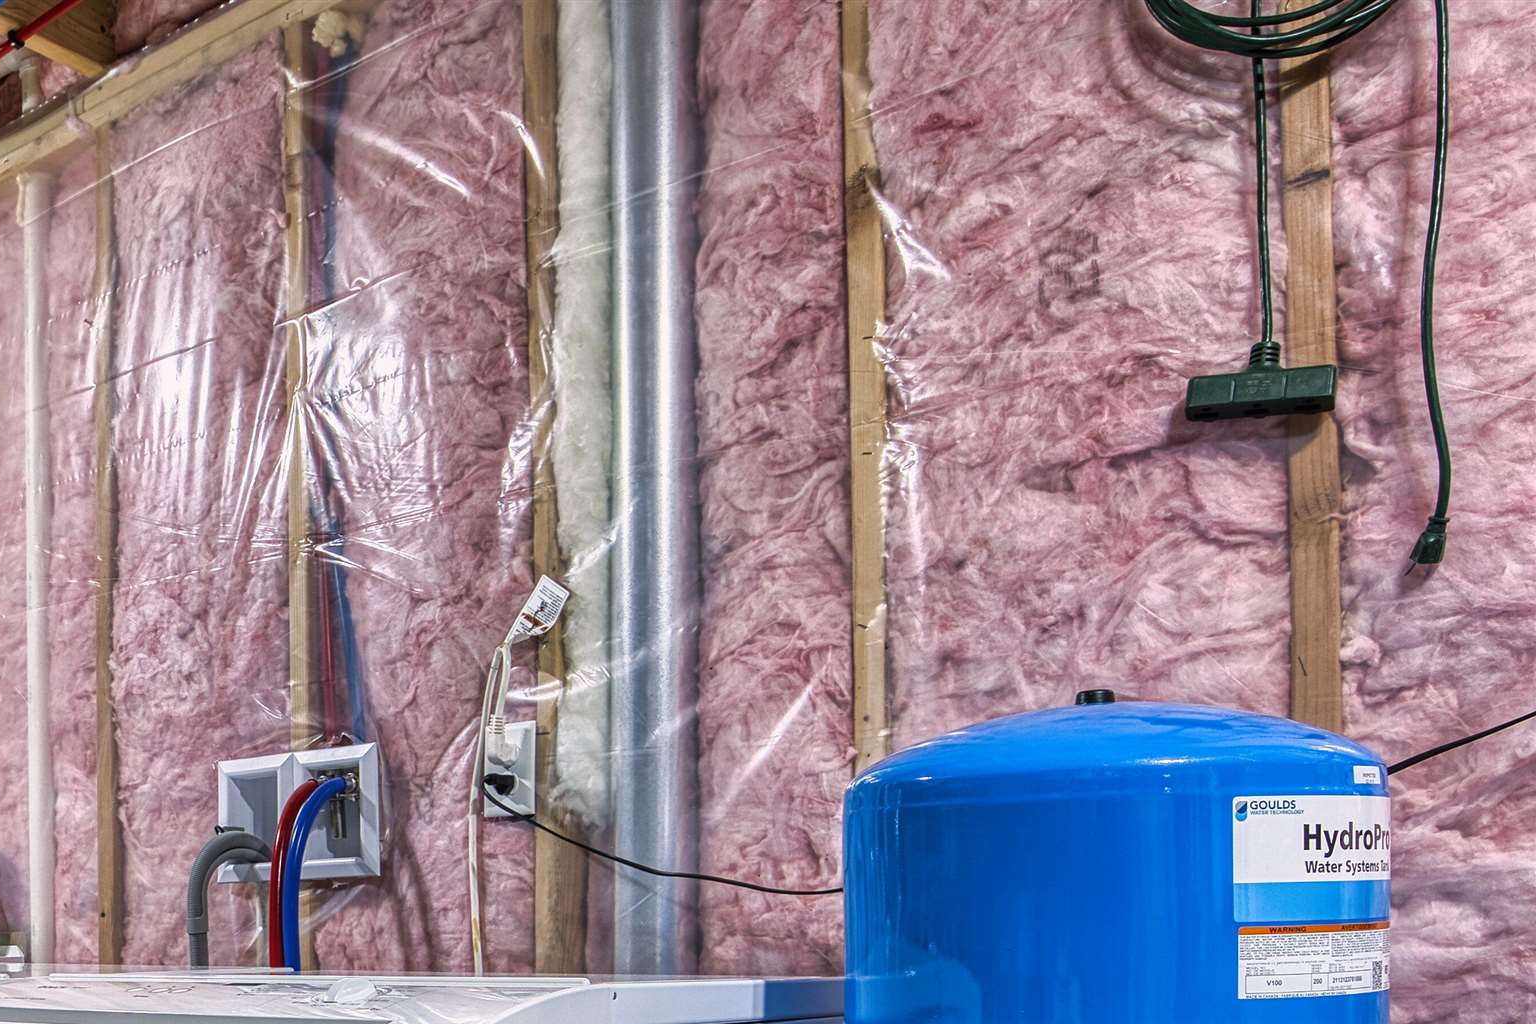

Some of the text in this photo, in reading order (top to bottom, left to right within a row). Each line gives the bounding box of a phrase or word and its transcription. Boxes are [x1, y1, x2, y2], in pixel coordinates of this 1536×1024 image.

[1249, 799, 1297, 810] GOULDS
[1303, 821, 1390, 859] HydroPro
[1304, 860, 1343, 874] Water
[1346, 859, 1380, 877] Systems
[1268, 926, 1307, 934] WARNING
